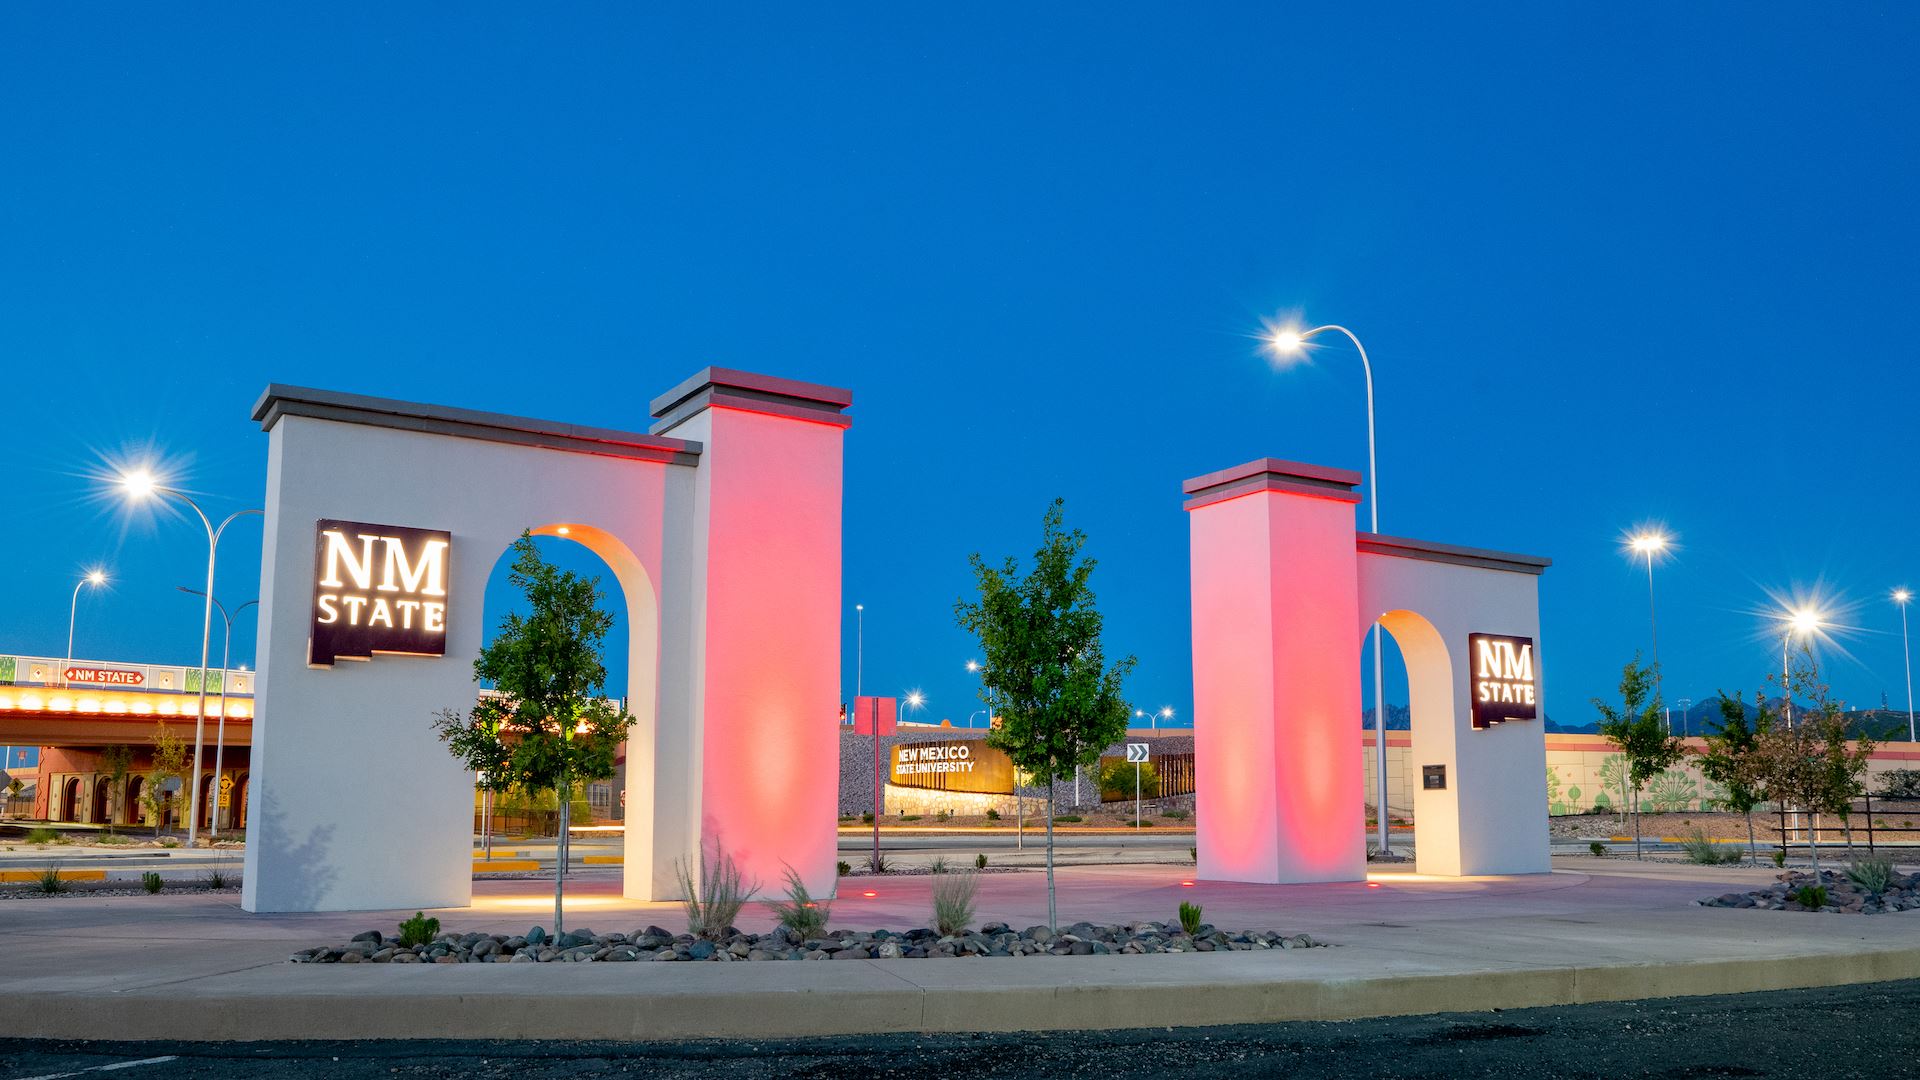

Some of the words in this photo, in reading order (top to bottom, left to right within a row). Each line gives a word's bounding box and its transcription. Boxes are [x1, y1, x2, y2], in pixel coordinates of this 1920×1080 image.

[319, 530, 449, 596] NM
[318, 594, 446, 632] STATE
[1477, 639, 1534, 681] NM
[75, 669, 95, 681] NM
[98, 671, 134, 683] STATE
[1479, 681, 1536, 705] STATE
[899, 748, 918, 762] NEW
[920, 745, 969, 760] MEXICO
[896, 764, 914, 775] STATE
[916, 761, 974, 773] UNIVERSITY
